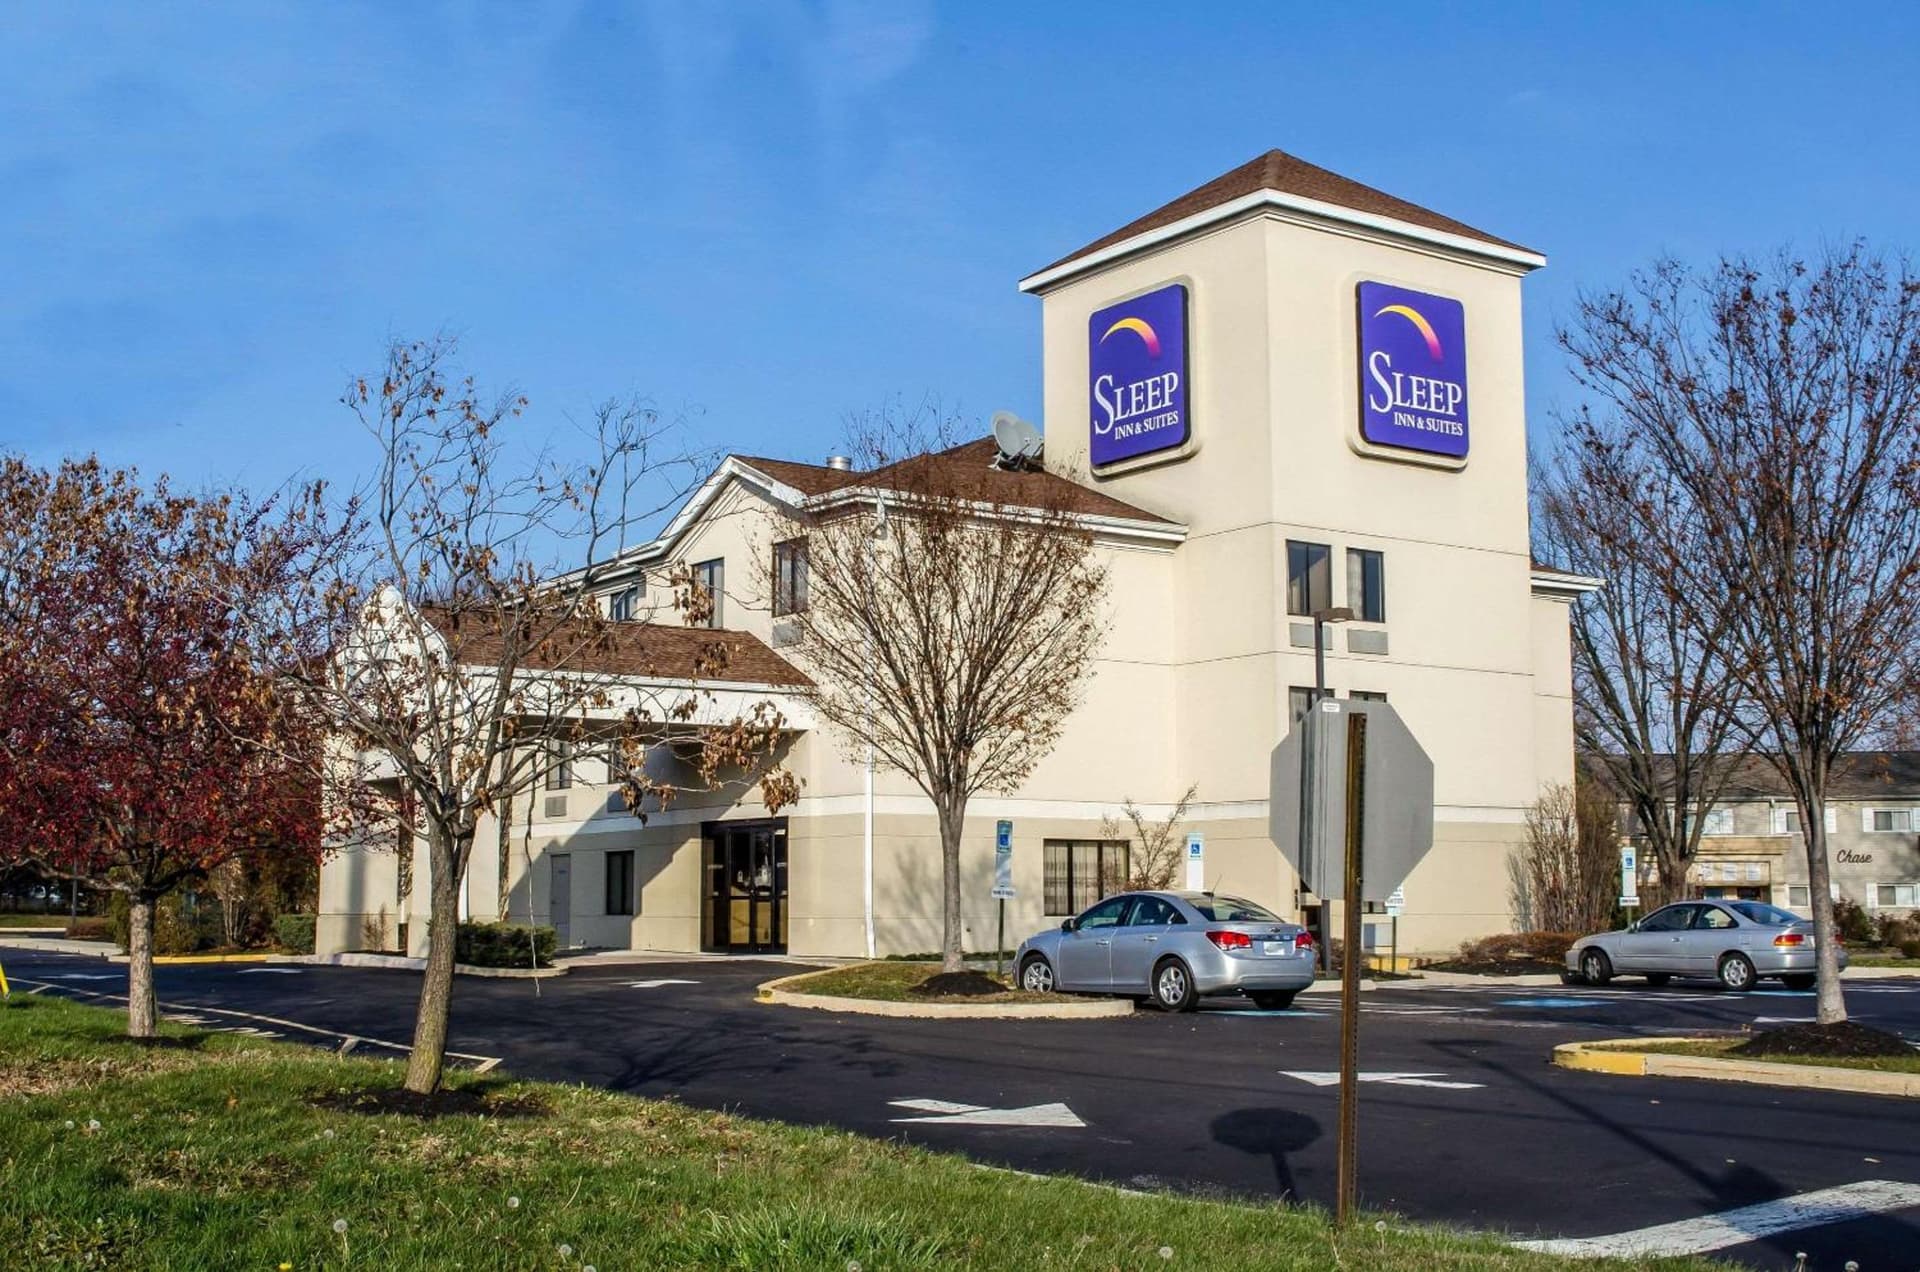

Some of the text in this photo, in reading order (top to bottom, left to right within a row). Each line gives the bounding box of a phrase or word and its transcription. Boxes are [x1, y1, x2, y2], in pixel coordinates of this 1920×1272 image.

[1369, 351, 1463, 416] SLEEP
[1094, 372, 1179, 435] SLEEP
[1114, 410, 1179, 440] INN & SUITES
[1393, 412, 1463, 436] INN & SUITES
[1836, 849, 1873, 864] Chase
